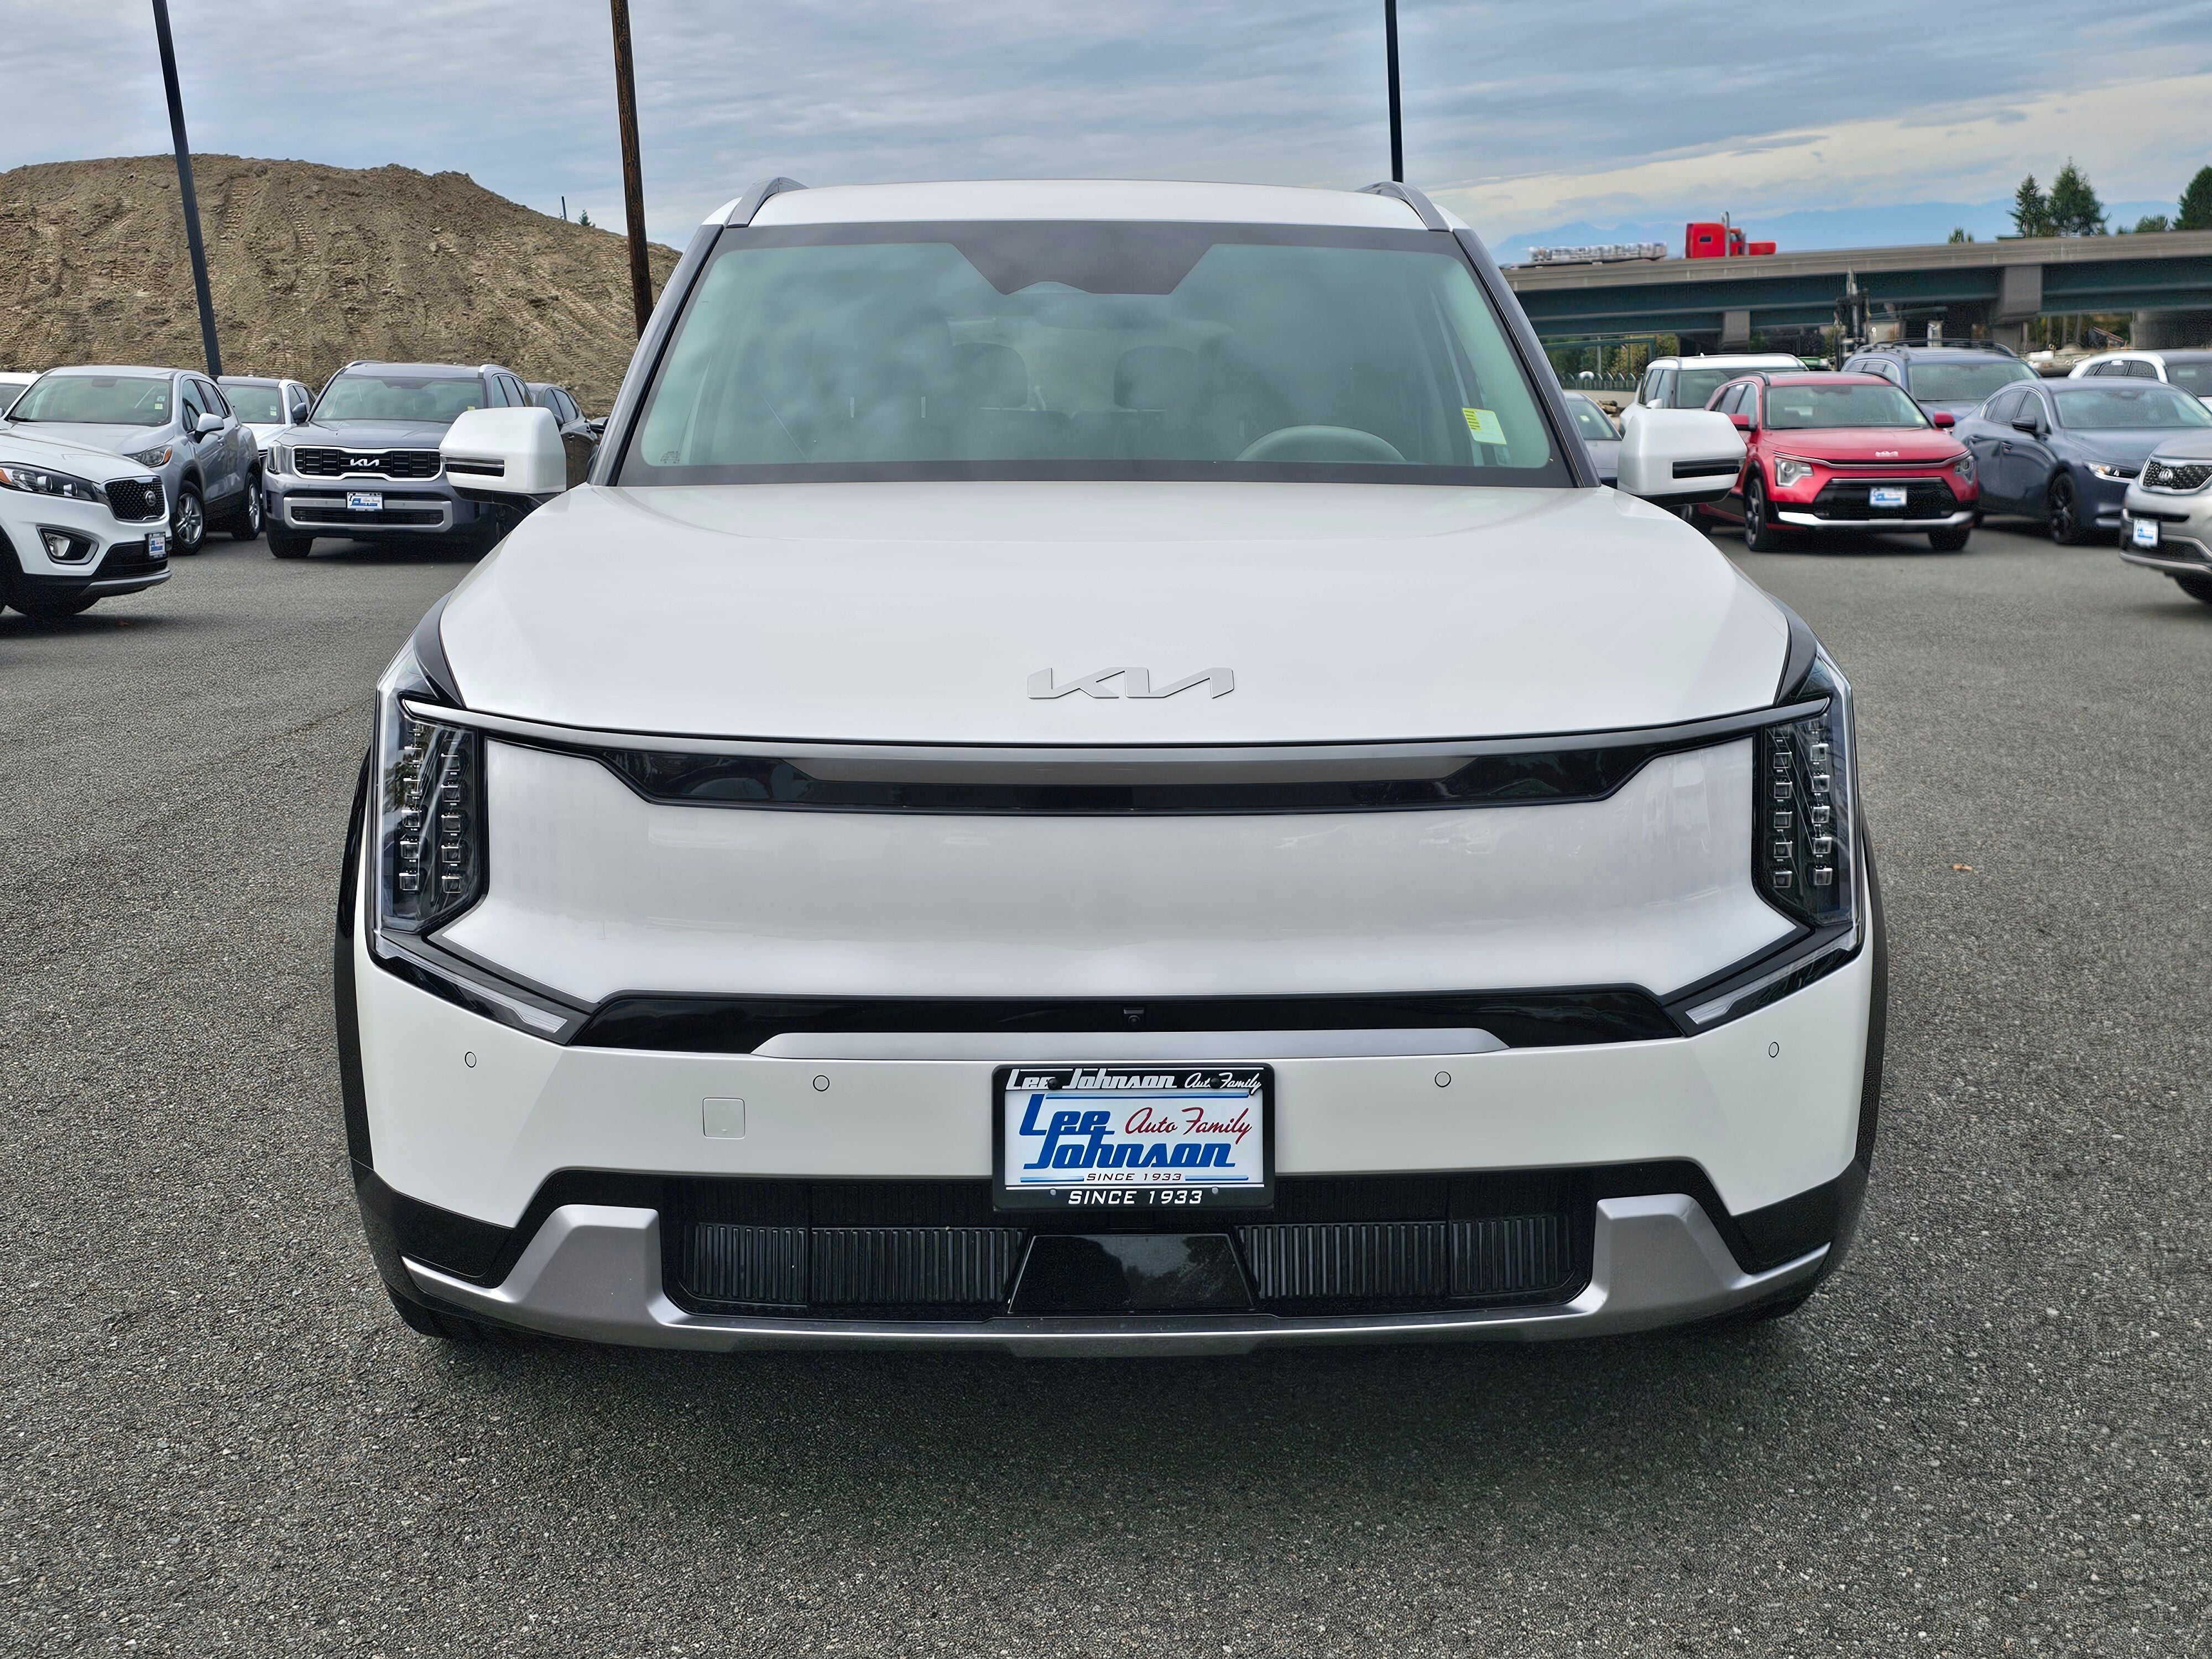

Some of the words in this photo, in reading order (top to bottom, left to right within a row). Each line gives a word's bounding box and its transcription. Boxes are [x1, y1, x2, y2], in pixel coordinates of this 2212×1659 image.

[1027, 666, 1234, 700] KIA
[1062, 1068, 1177, 1089] Johnson
[1185, 1072, 1212, 1088] Aut
[1218, 1072, 1261, 1094] Family
[1019, 1093, 1115, 1136] Lee
[1125, 1107, 1178, 1134] Auto
[1181, 1107, 1253, 1145] Family
[1023, 1134, 1236, 1170] Johnson
[1086, 1173, 1135, 1181] SINCE
[1068, 1190, 1138, 1204] SINCE
[1149, 1190, 1203, 1204] 1933
